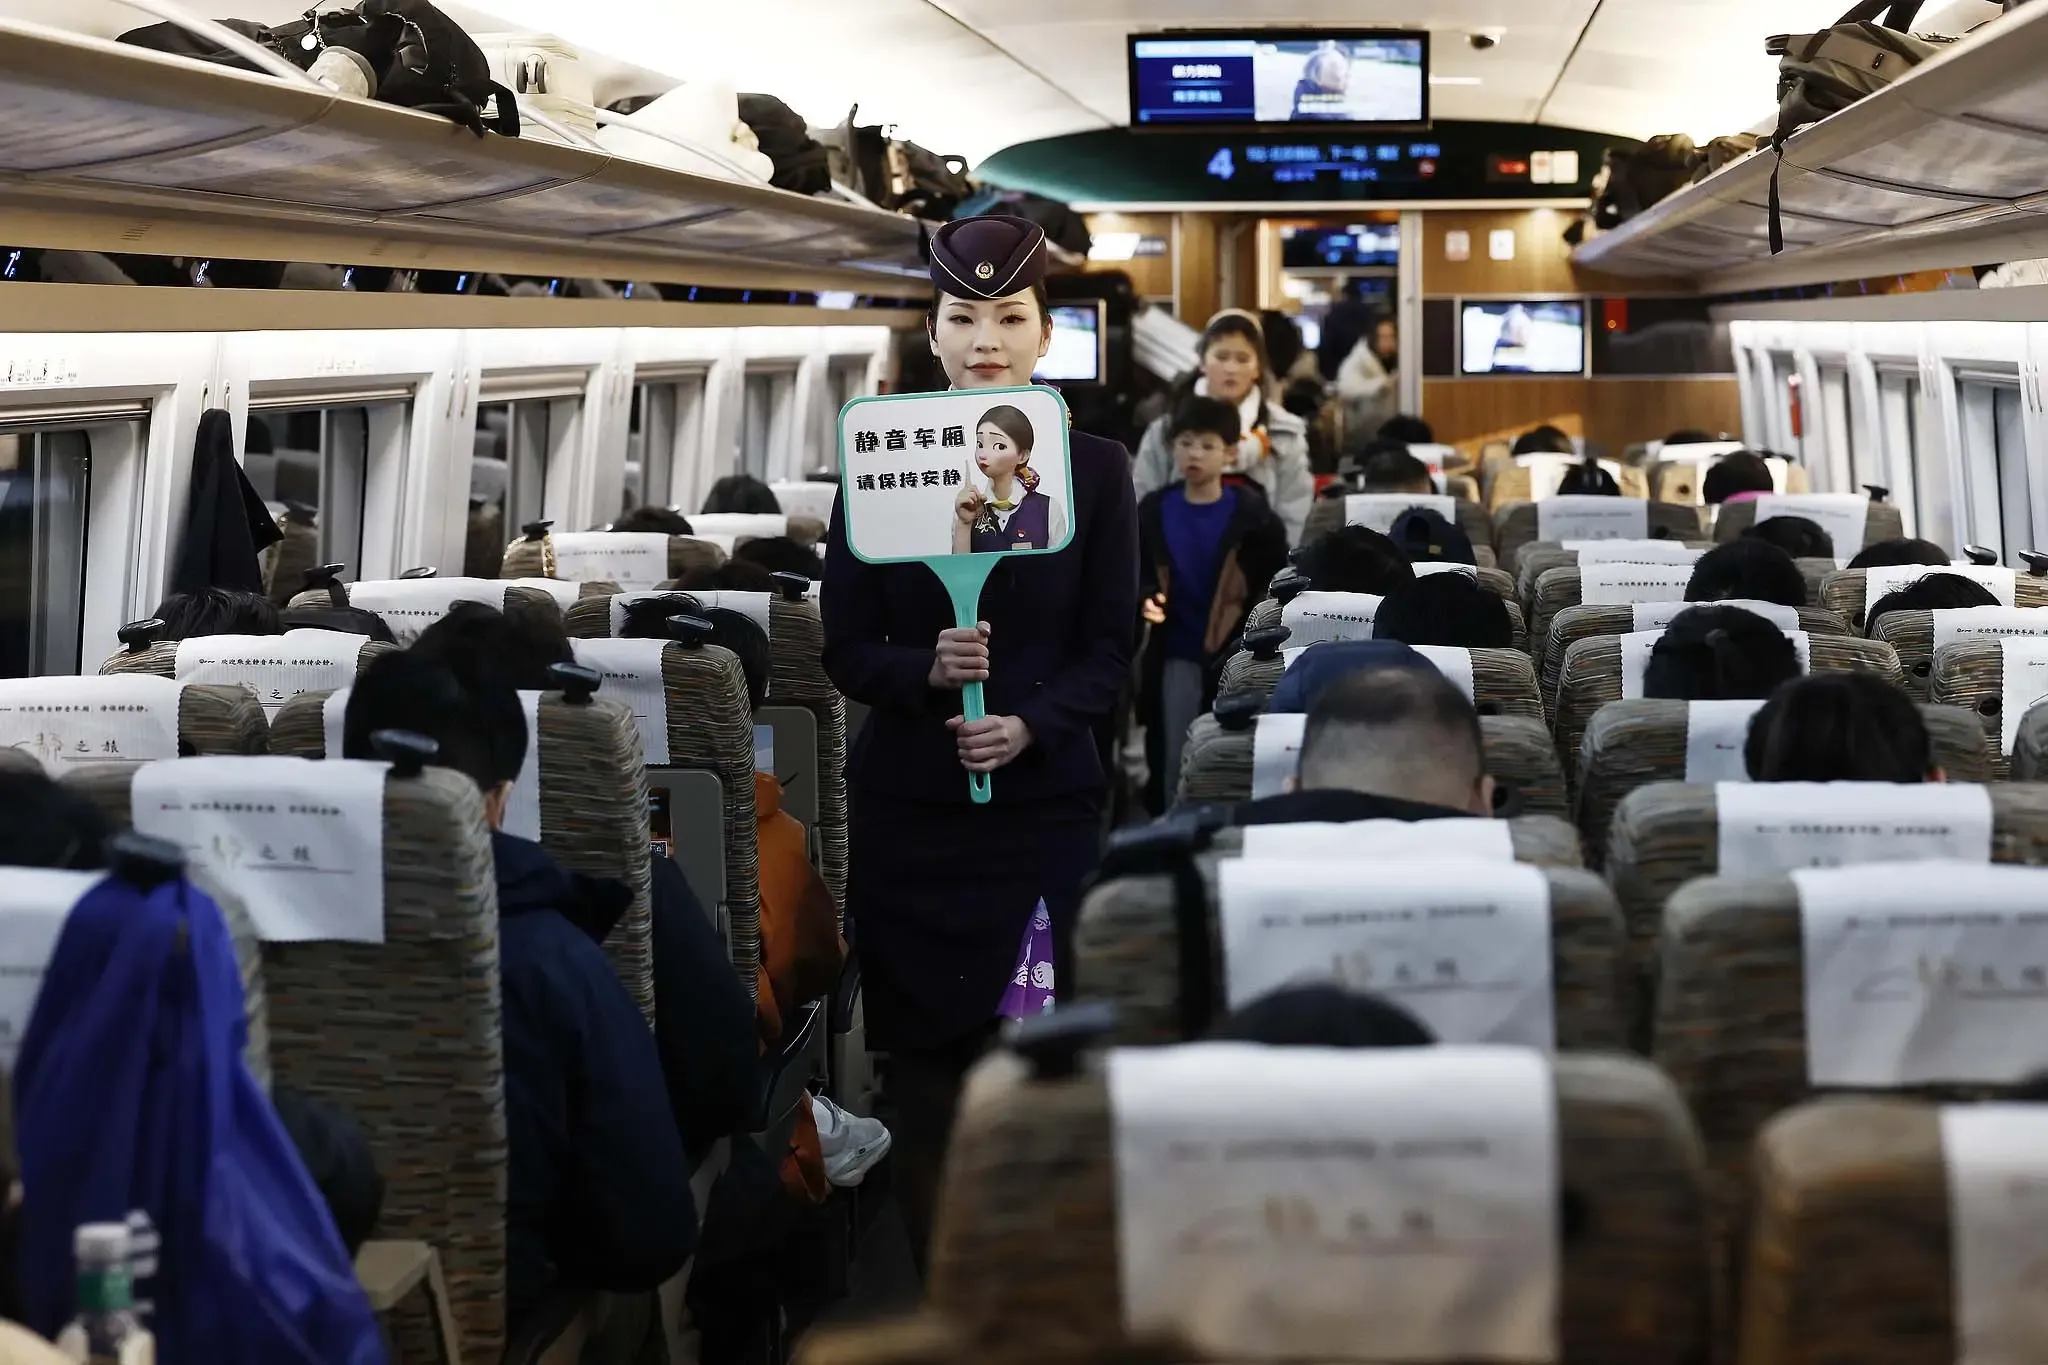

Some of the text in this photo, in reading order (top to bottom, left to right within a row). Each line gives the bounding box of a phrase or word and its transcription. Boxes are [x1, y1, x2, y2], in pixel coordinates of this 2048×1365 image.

[1207, 148, 1235, 180] 4
[854, 425, 966, 453] 静音车厢
[856, 469, 962, 491] 请保持安静
